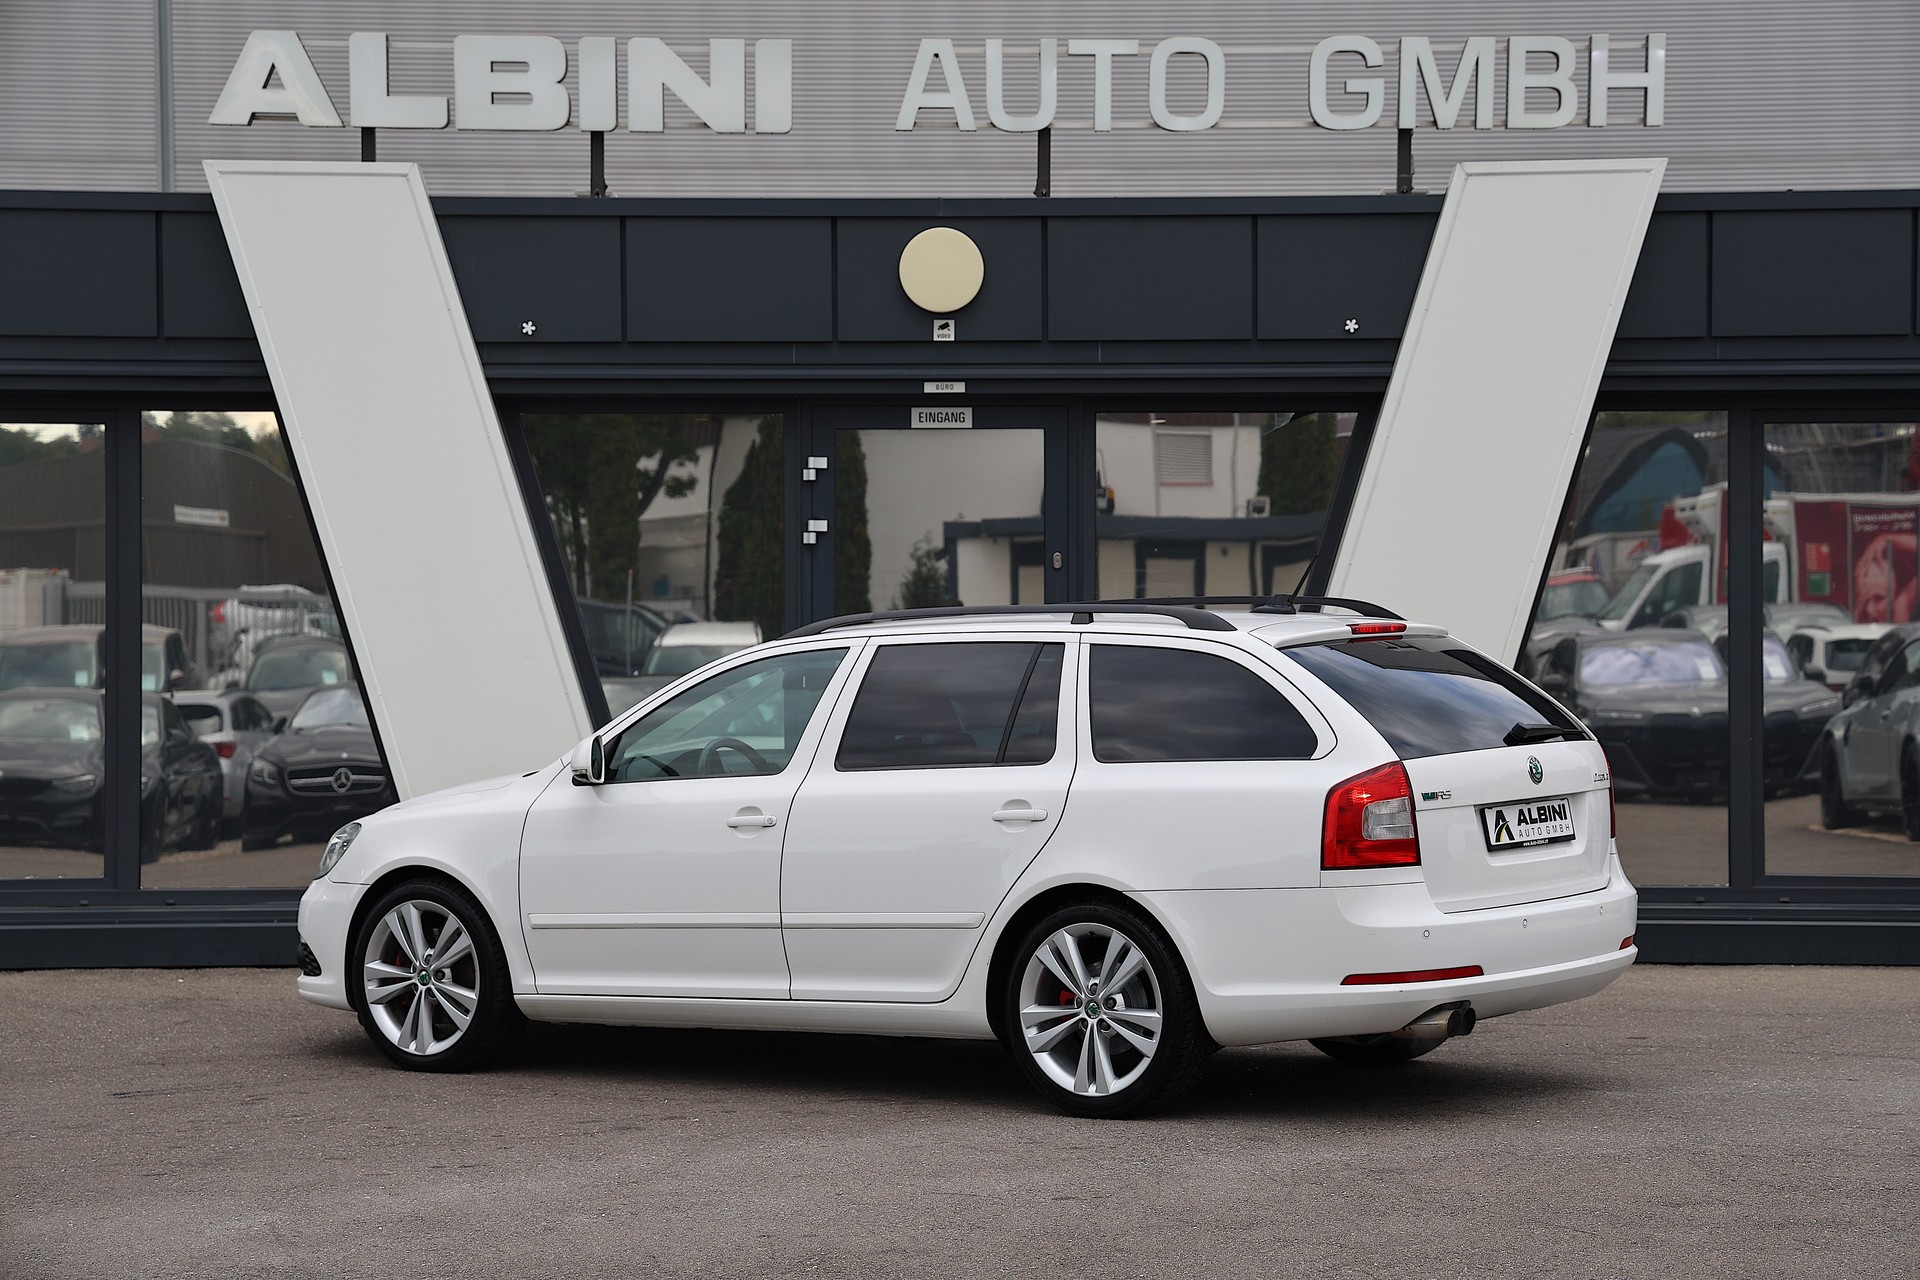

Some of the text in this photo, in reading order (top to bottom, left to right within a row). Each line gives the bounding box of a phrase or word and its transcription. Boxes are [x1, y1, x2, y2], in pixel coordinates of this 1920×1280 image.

[208, 30, 1667, 133] ALBINI AUTO GMBH
[935, 383, 954, 391] BÜRO
[918, 411, 966, 423] EINGANG
[1517, 803, 1568, 826] ALBINI
[1518, 823, 1571, 839] AUTO GMBH
